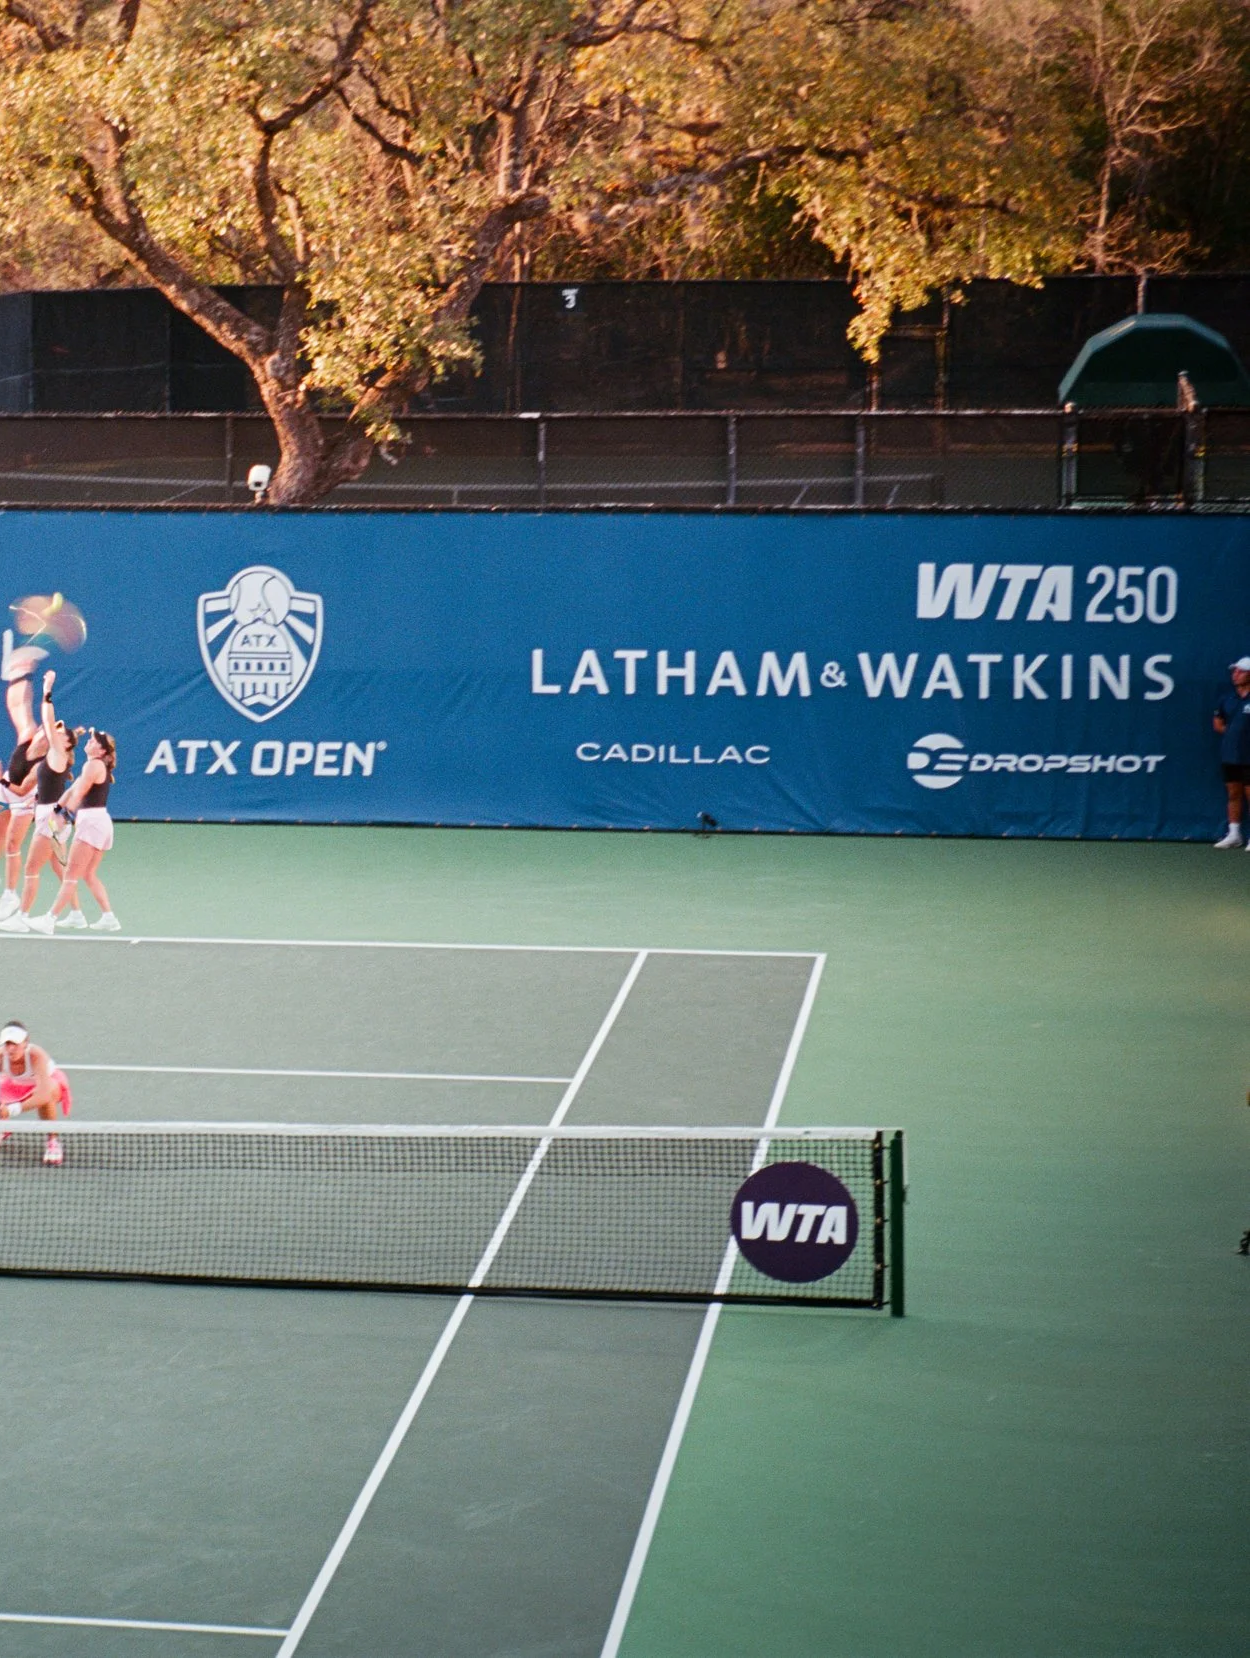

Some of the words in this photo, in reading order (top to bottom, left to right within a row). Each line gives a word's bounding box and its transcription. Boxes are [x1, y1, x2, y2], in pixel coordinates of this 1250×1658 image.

[917, 563, 1072, 621] WTA
[1085, 565, 1177, 624] 250
[240, 634, 277, 648] ATX
[532, 648, 811, 697] LATHAM
[820, 661, 847, 688] &
[857, 652, 1174, 700] WATKINS
[144, 739, 241, 775] ATX
[576, 742, 770, 764] CADILLAC
[969, 753, 1165, 773] DROPSHOT
[740, 1201, 848, 1245] WTA
